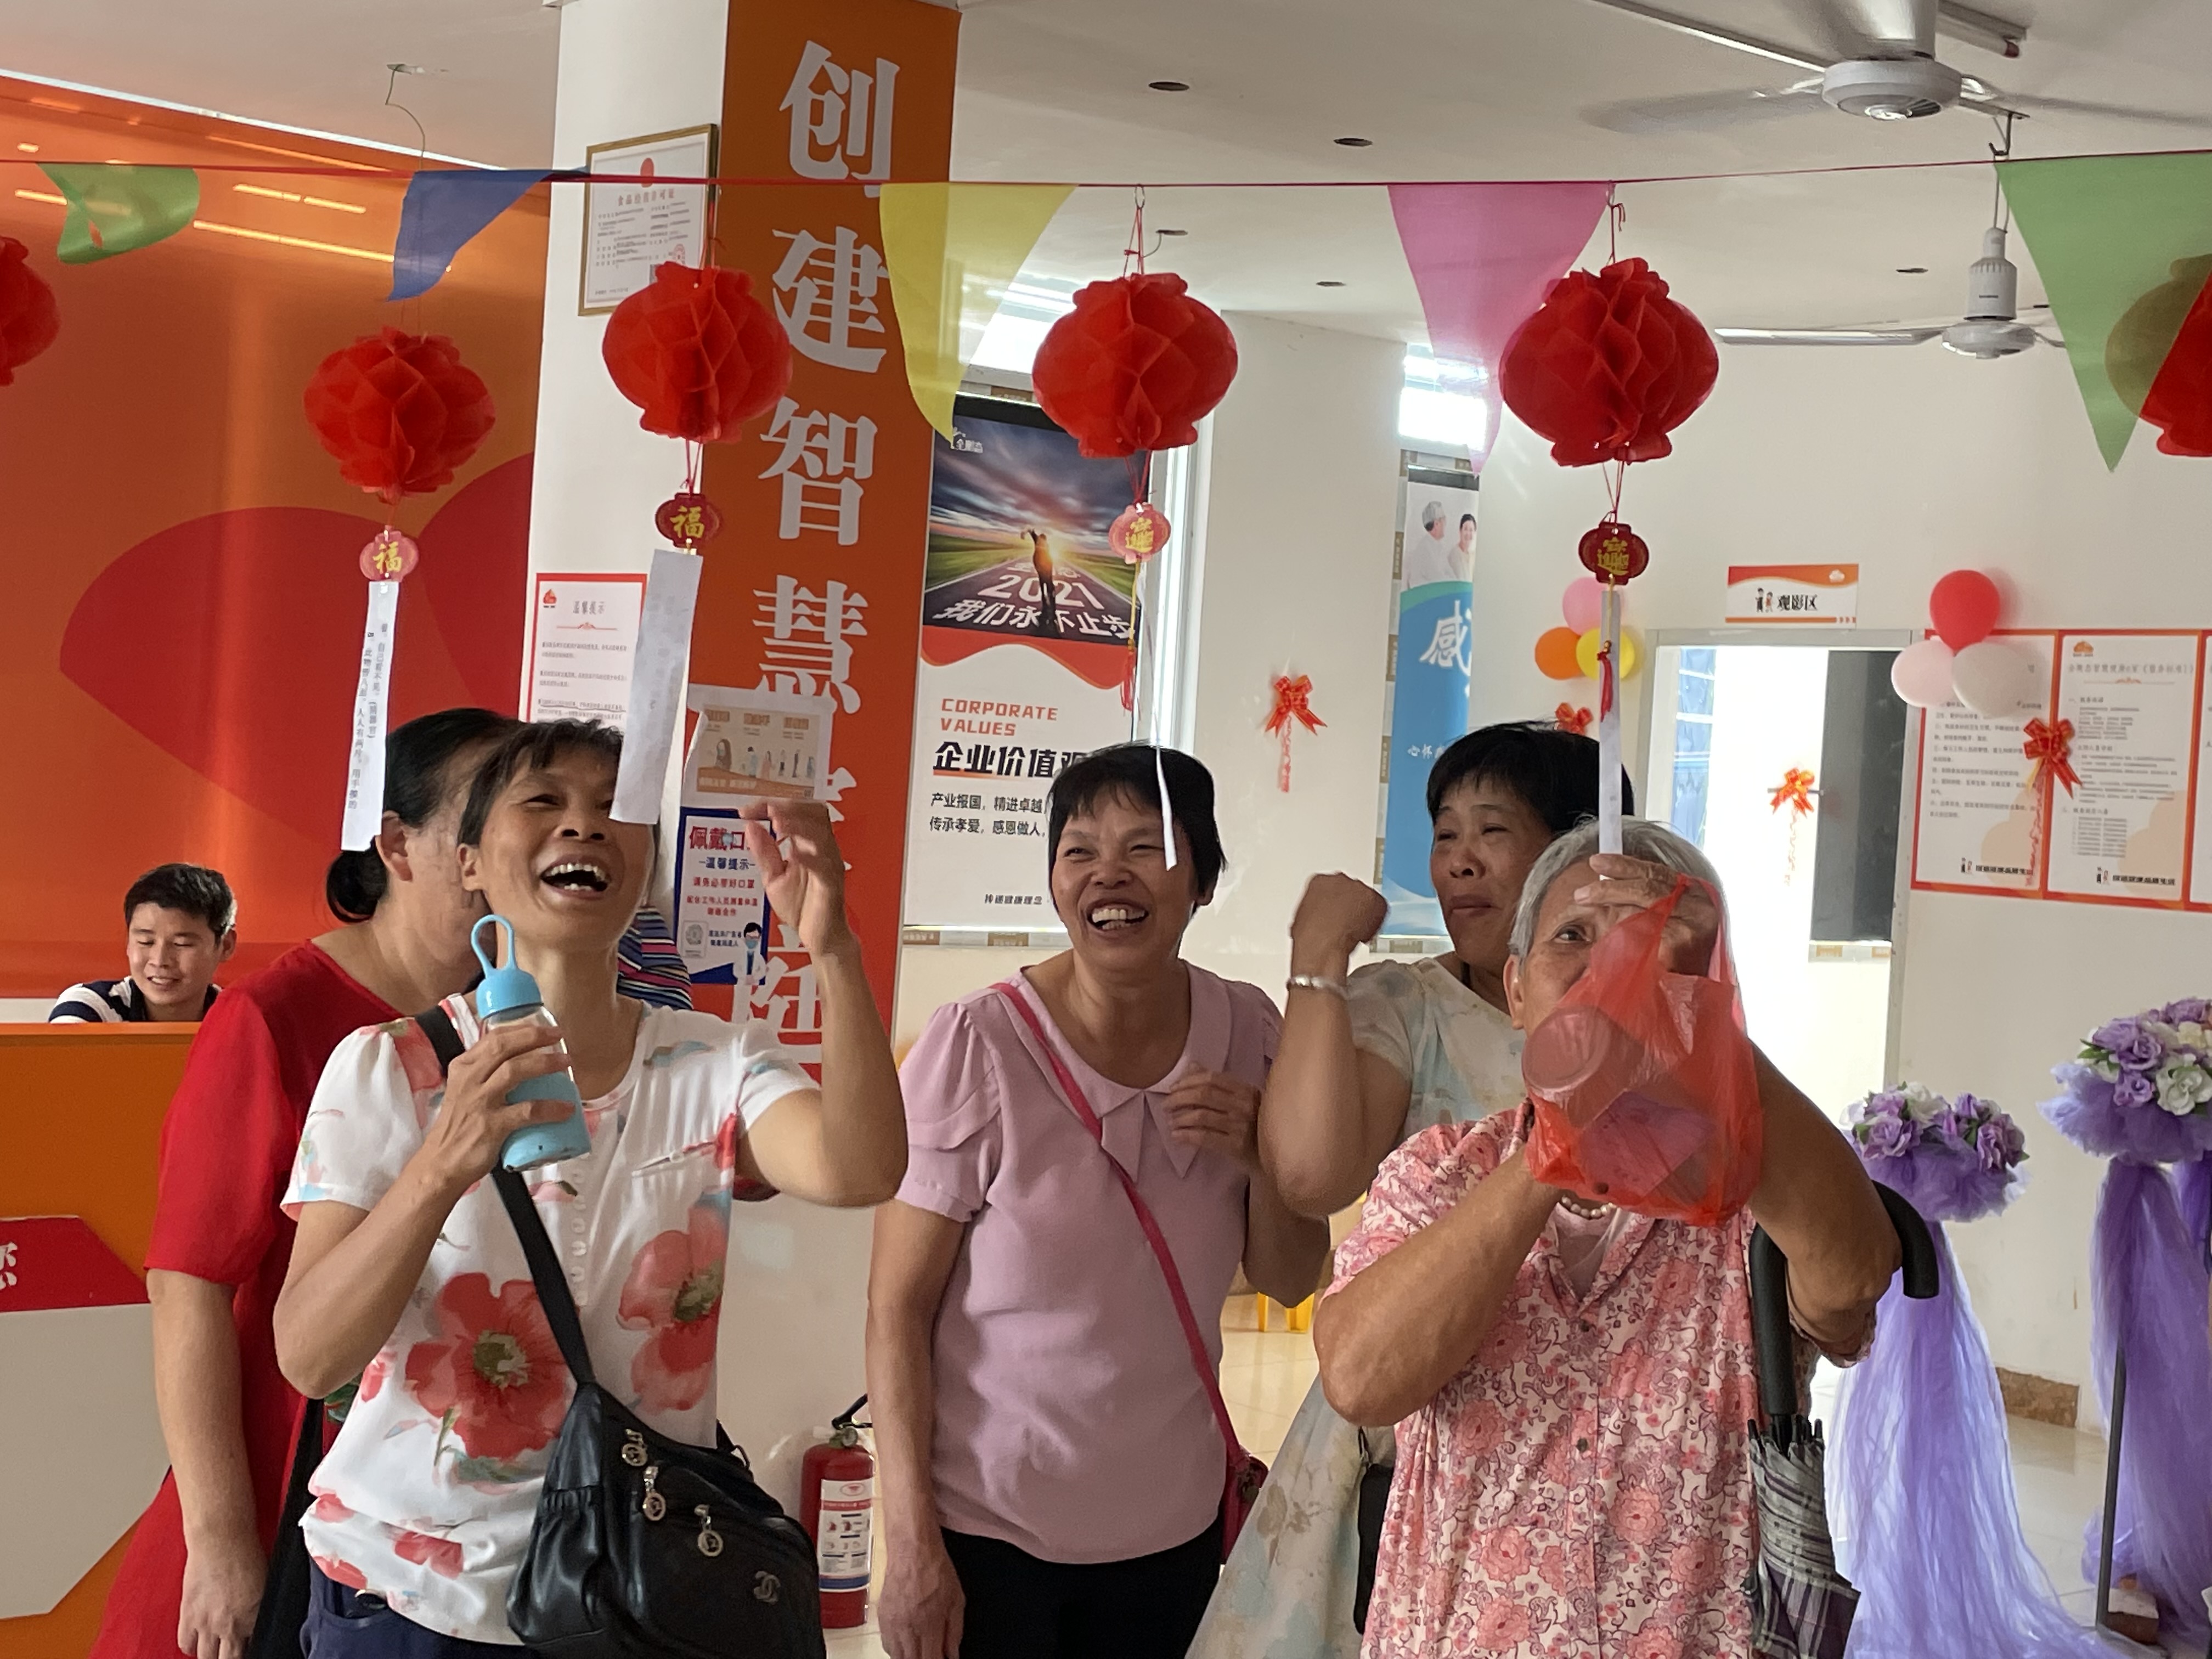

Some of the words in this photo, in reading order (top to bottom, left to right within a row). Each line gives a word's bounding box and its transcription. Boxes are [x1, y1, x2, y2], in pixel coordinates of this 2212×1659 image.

[669, 505, 706, 539] 福
[374, 540, 403, 573] 福
[731, 37, 900, 1064] 创建智慧庭
[977, 574, 1105, 610] 2021
[1776, 594, 1818, 611] 观影区
[933, 599, 1136, 640] 我们永不止步
[941, 698, 1059, 721] CORPORATE
[940, 718, 1017, 736] VALUES
[689, 826, 750, 851] 佩戴口
[706, 856, 749, 870] 温馨提示
